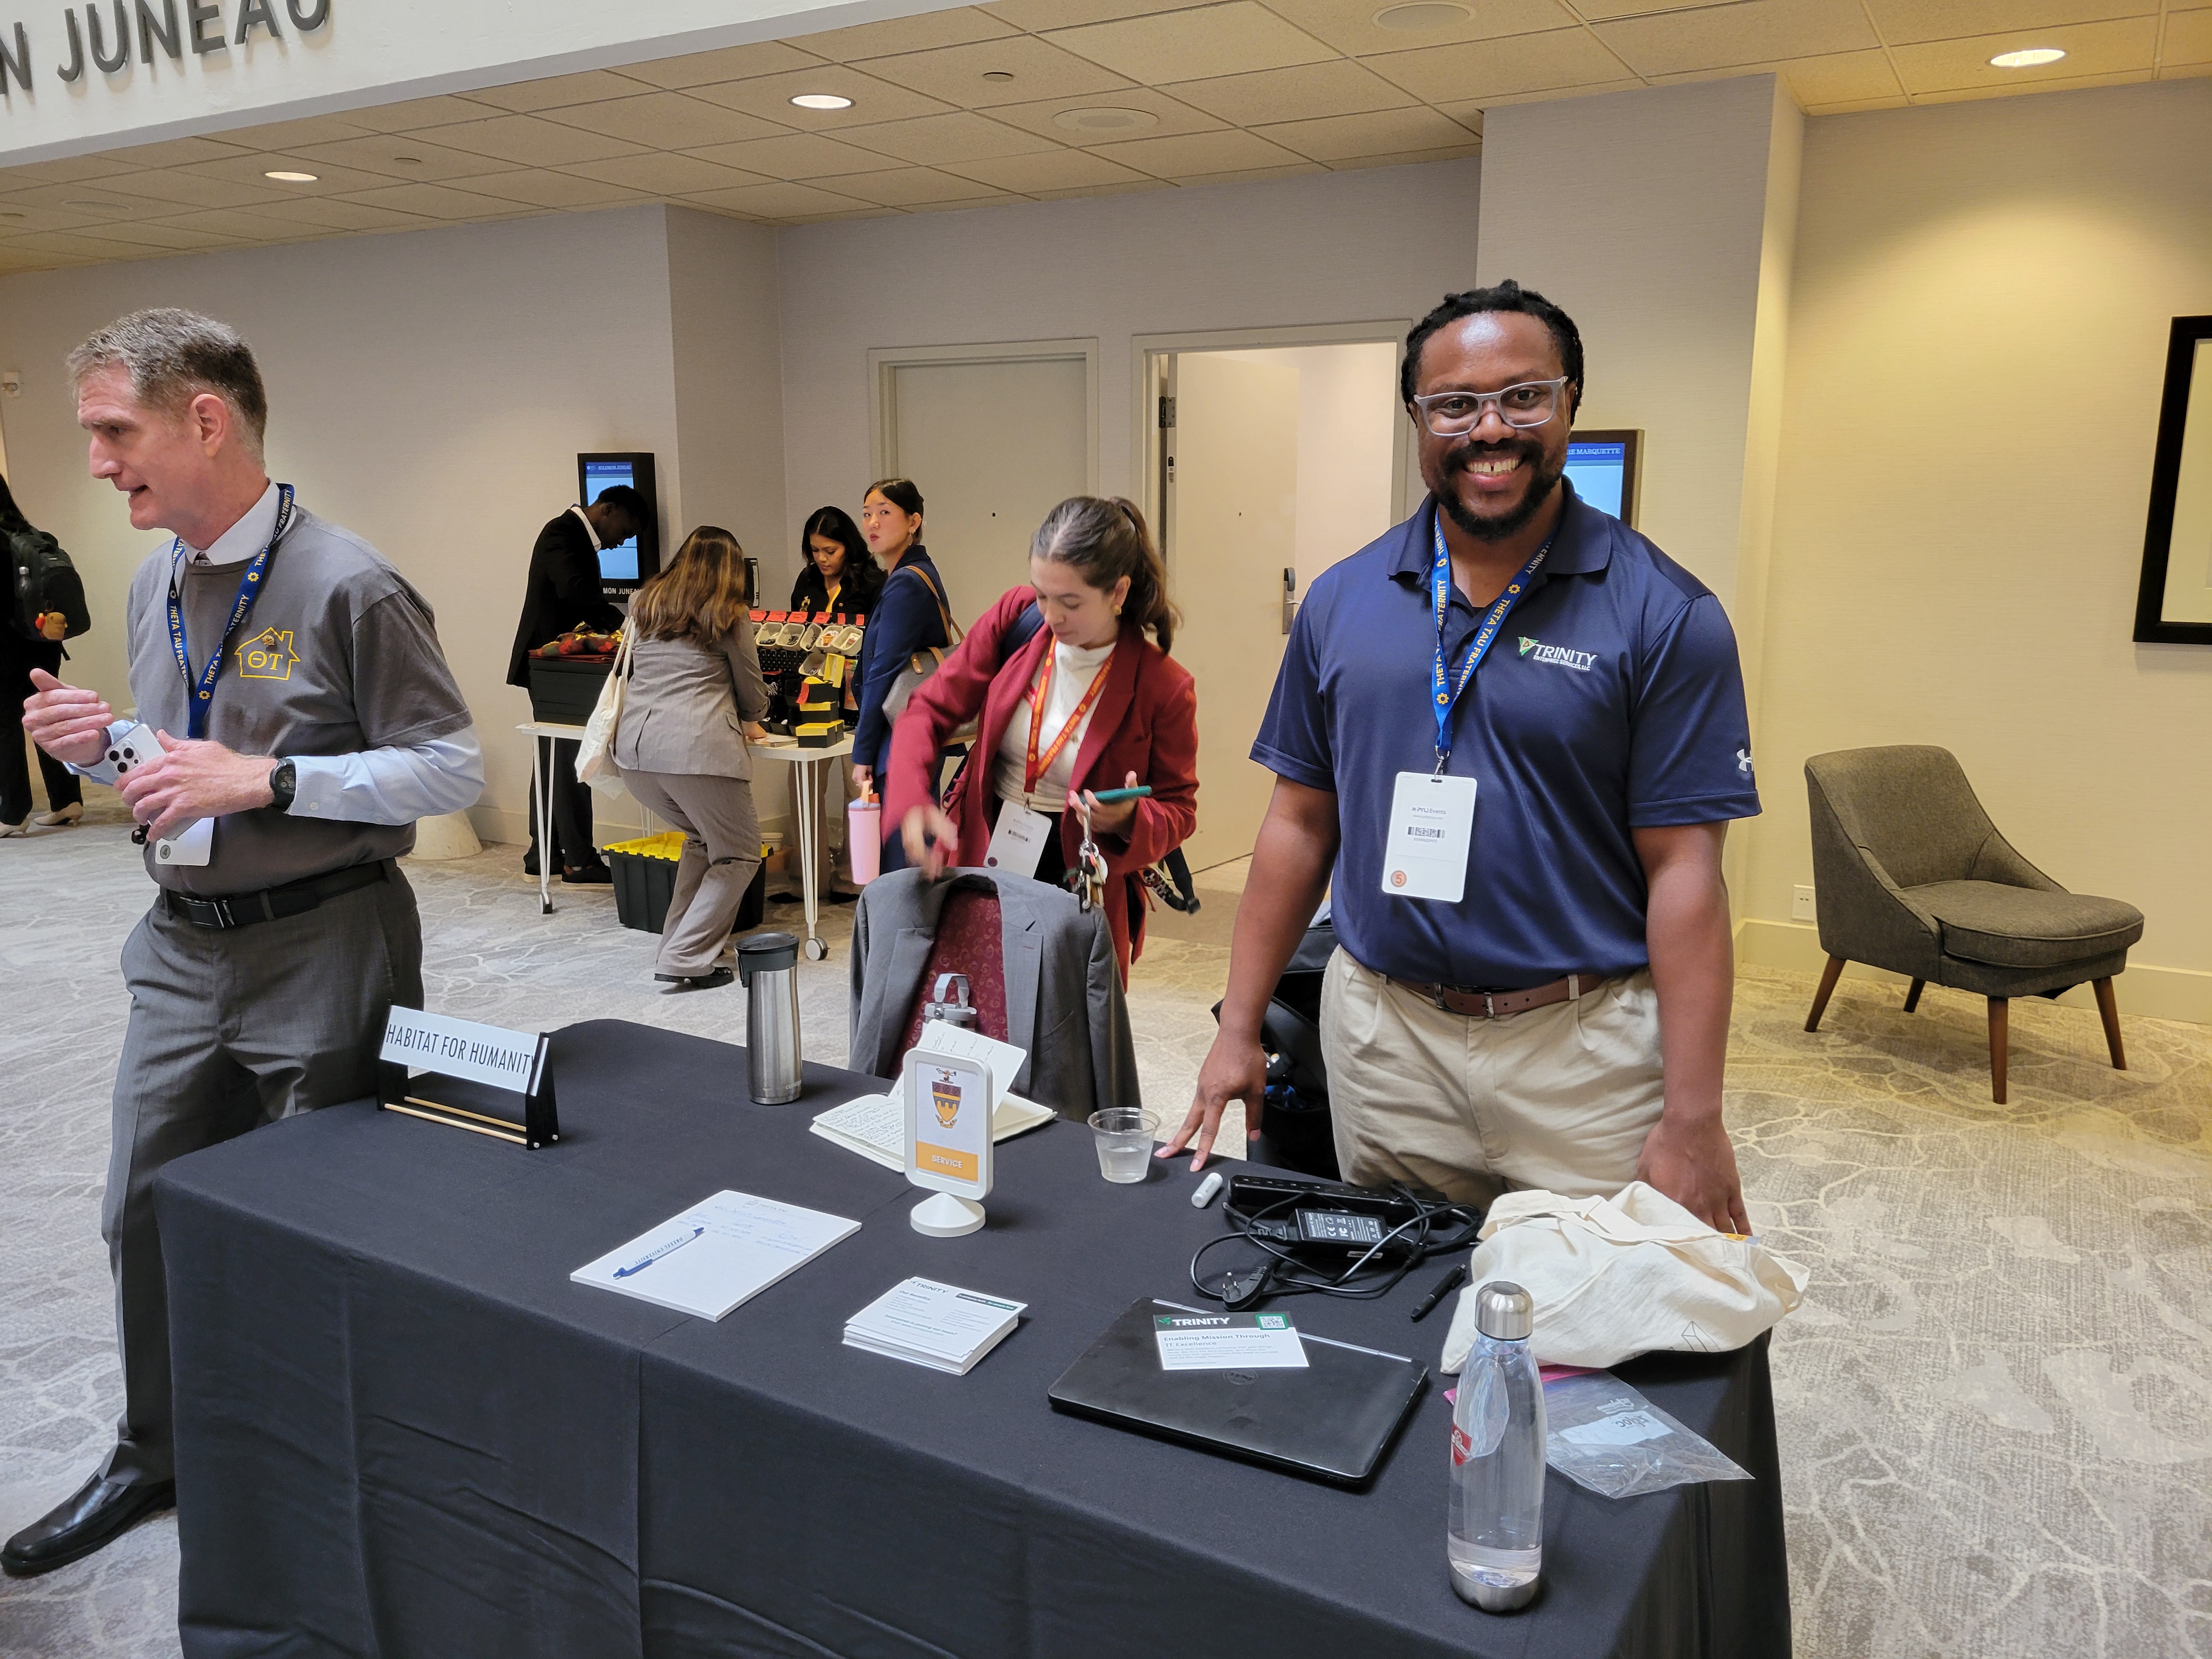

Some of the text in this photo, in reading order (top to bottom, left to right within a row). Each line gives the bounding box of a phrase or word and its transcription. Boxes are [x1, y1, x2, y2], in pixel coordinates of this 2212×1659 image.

[278, 489, 292, 528] FRATERNITY
[254, 545, 268, 567] THET
[170, 605, 180, 631] THETA
[225, 594, 250, 636] ATERNITY
[1437, 580, 1447, 631] FRATERNITY
[1487, 599, 1511, 625] THETA
[173, 631, 183, 648] TAU
[1476, 628, 1493, 647] TAU
[1536, 644, 1599, 666] TRINITY
[204, 659, 219, 685] THETA
[1436, 654, 1445, 687] THETA
[1396, 874, 1403, 884] 5
[386, 1024, 534, 1075] HABITAT FOR HUMANIT
[932, 1154, 962, 1169] SERVICE
[635, 1237, 683, 1265] DREXEL UNIVERSITY
[916, 1283, 949, 1294] TRINITY
[1172, 1317, 1231, 1327] TRINITY
